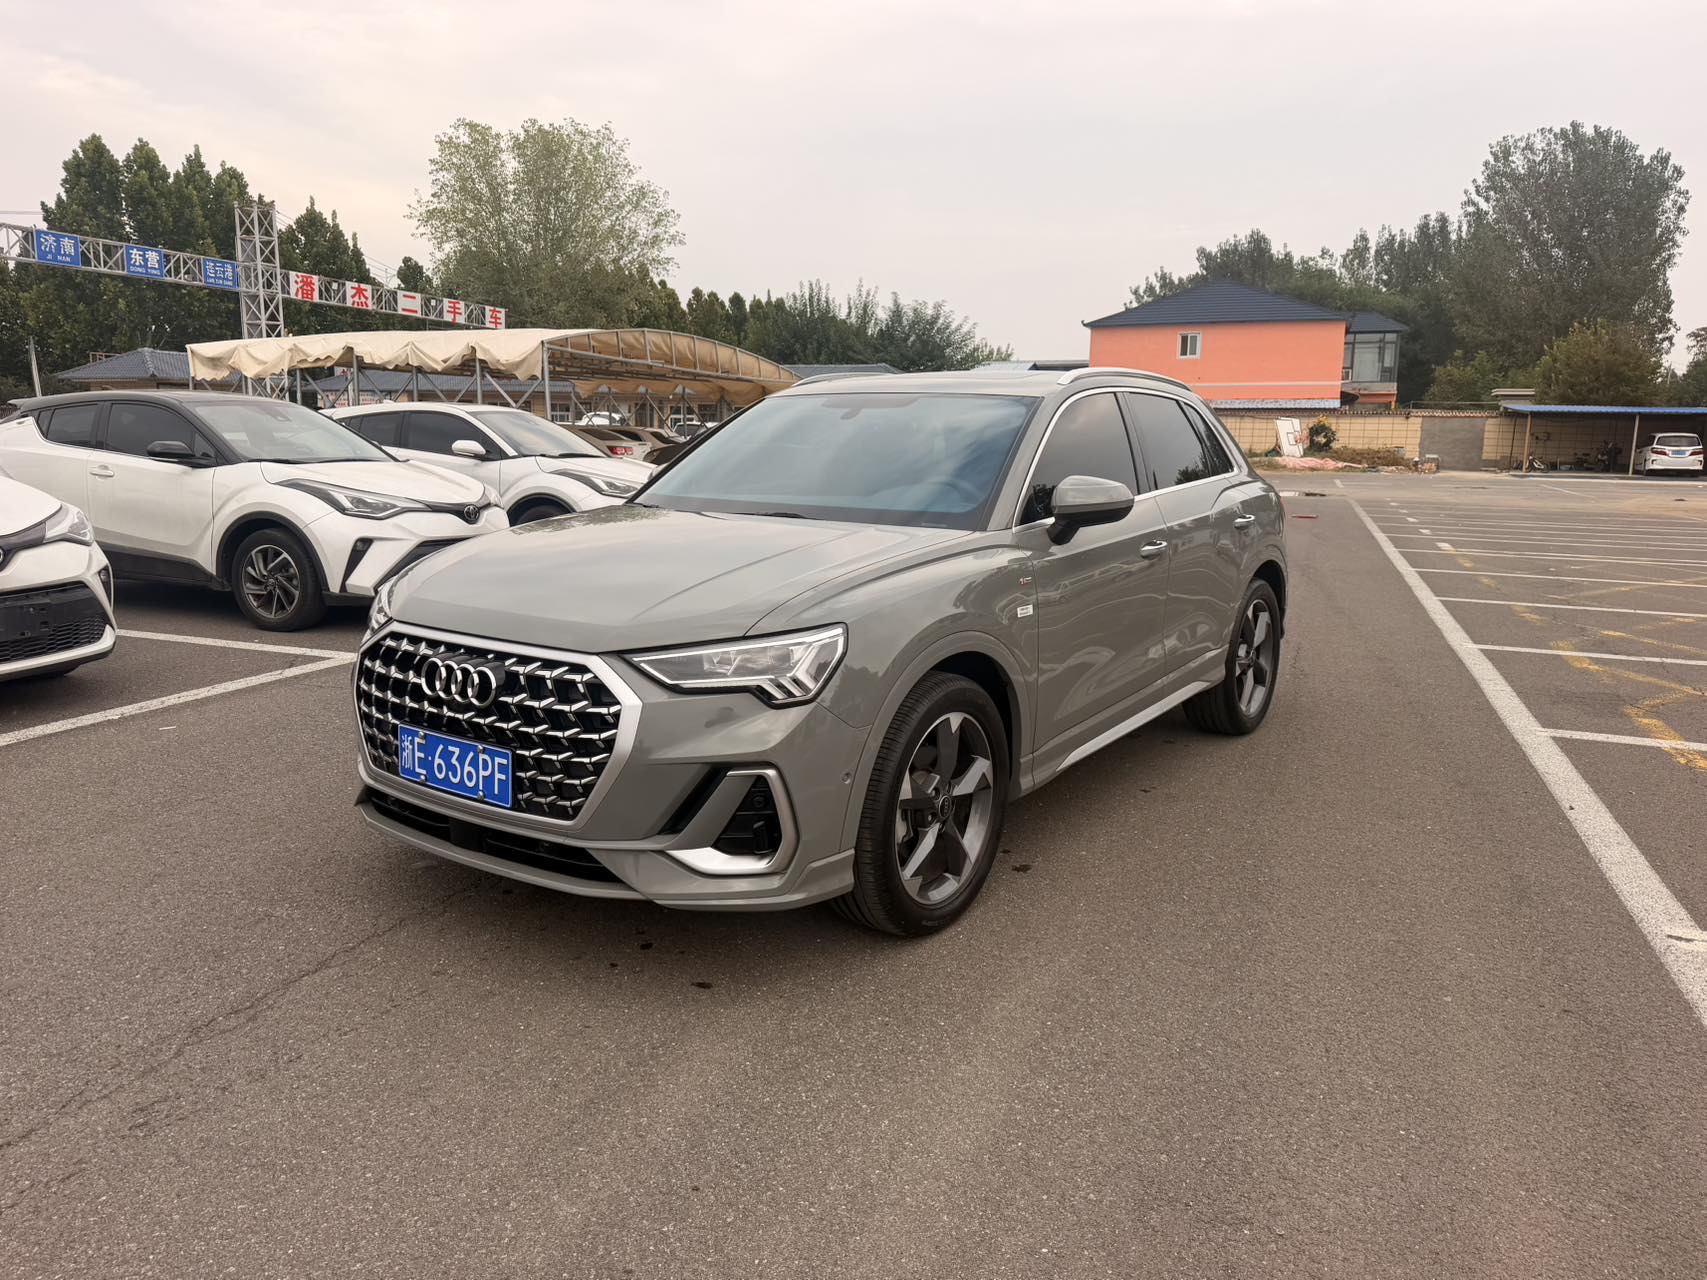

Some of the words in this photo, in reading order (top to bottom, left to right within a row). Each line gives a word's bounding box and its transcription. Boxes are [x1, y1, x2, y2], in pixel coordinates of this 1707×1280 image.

[40, 233, 75, 256] 济南
[129, 248, 160, 269] 东营
[294, 273, 503, 329] 潘杰二手车
